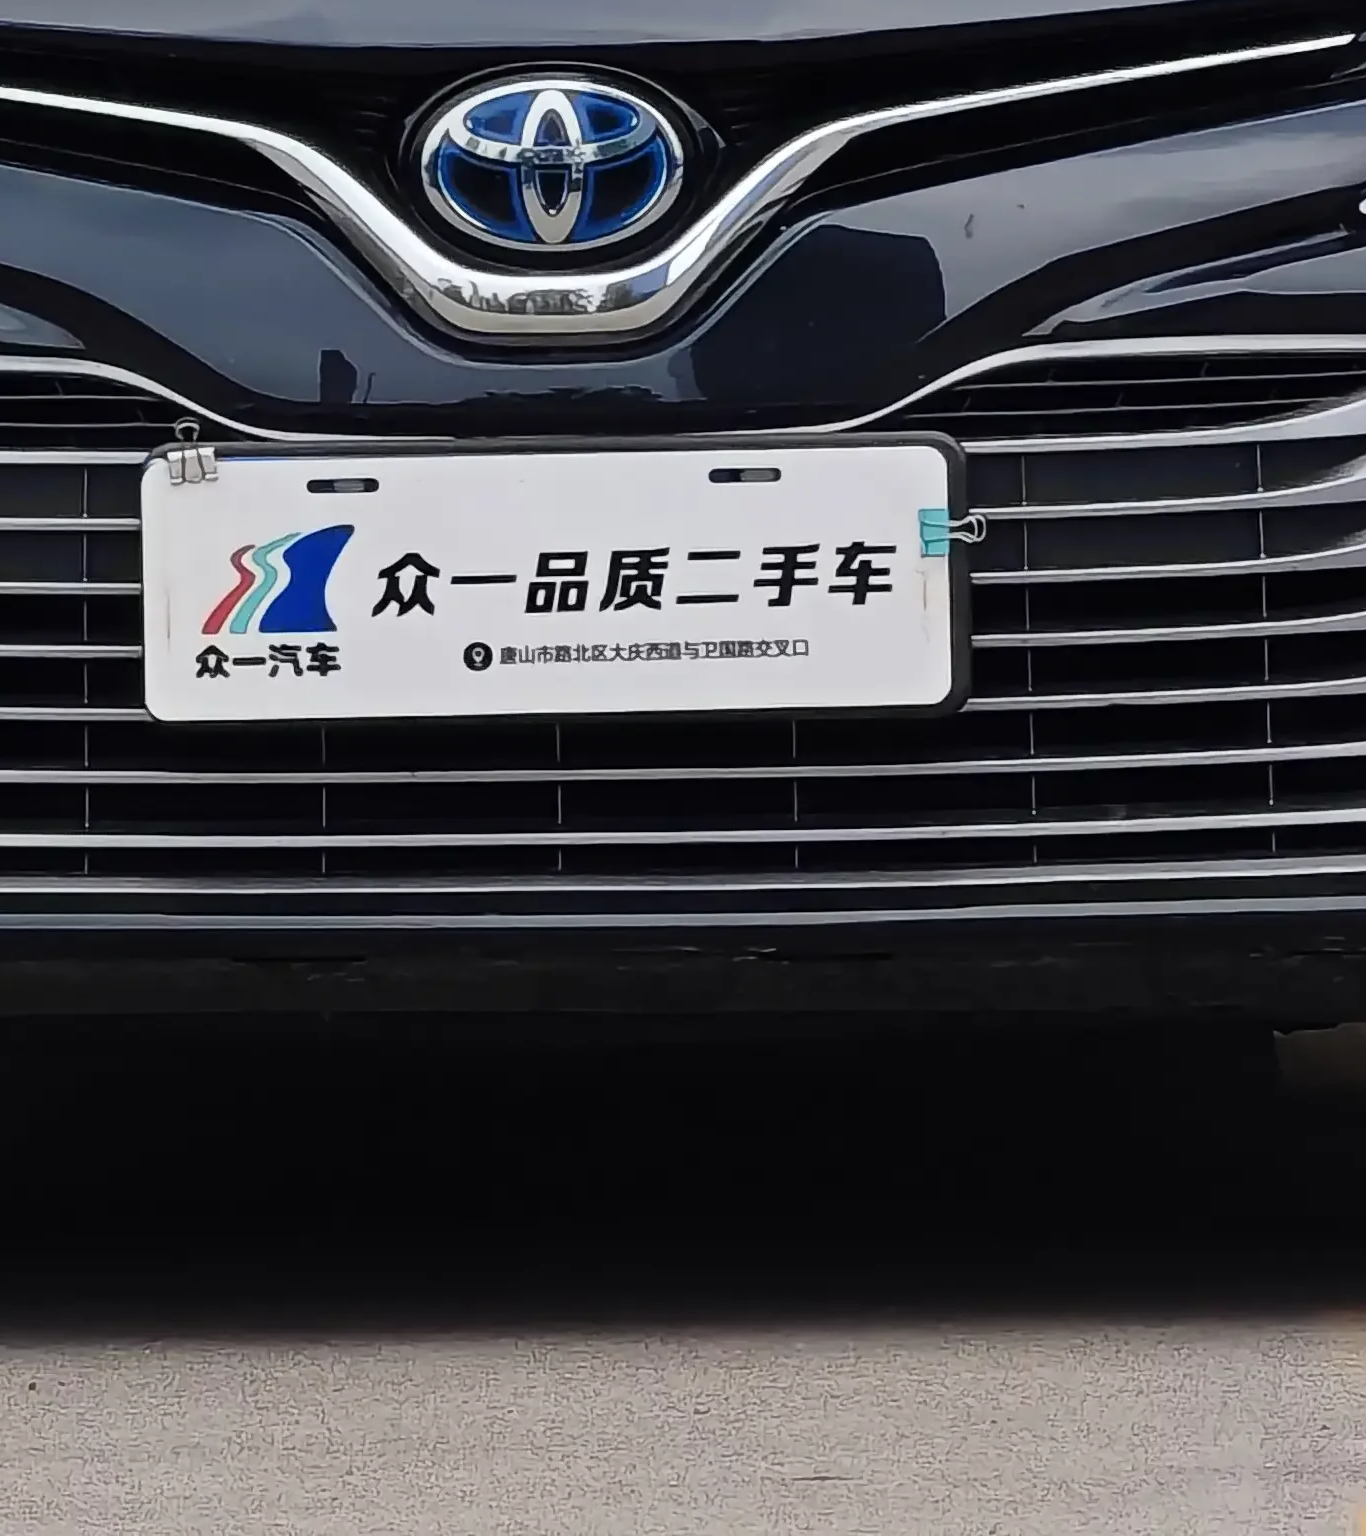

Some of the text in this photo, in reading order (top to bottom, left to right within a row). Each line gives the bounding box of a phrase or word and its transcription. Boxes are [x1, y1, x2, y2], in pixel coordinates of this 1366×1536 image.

[370, 540, 898, 618] 众一品质二手车
[195, 641, 342, 679] 众一汽车
